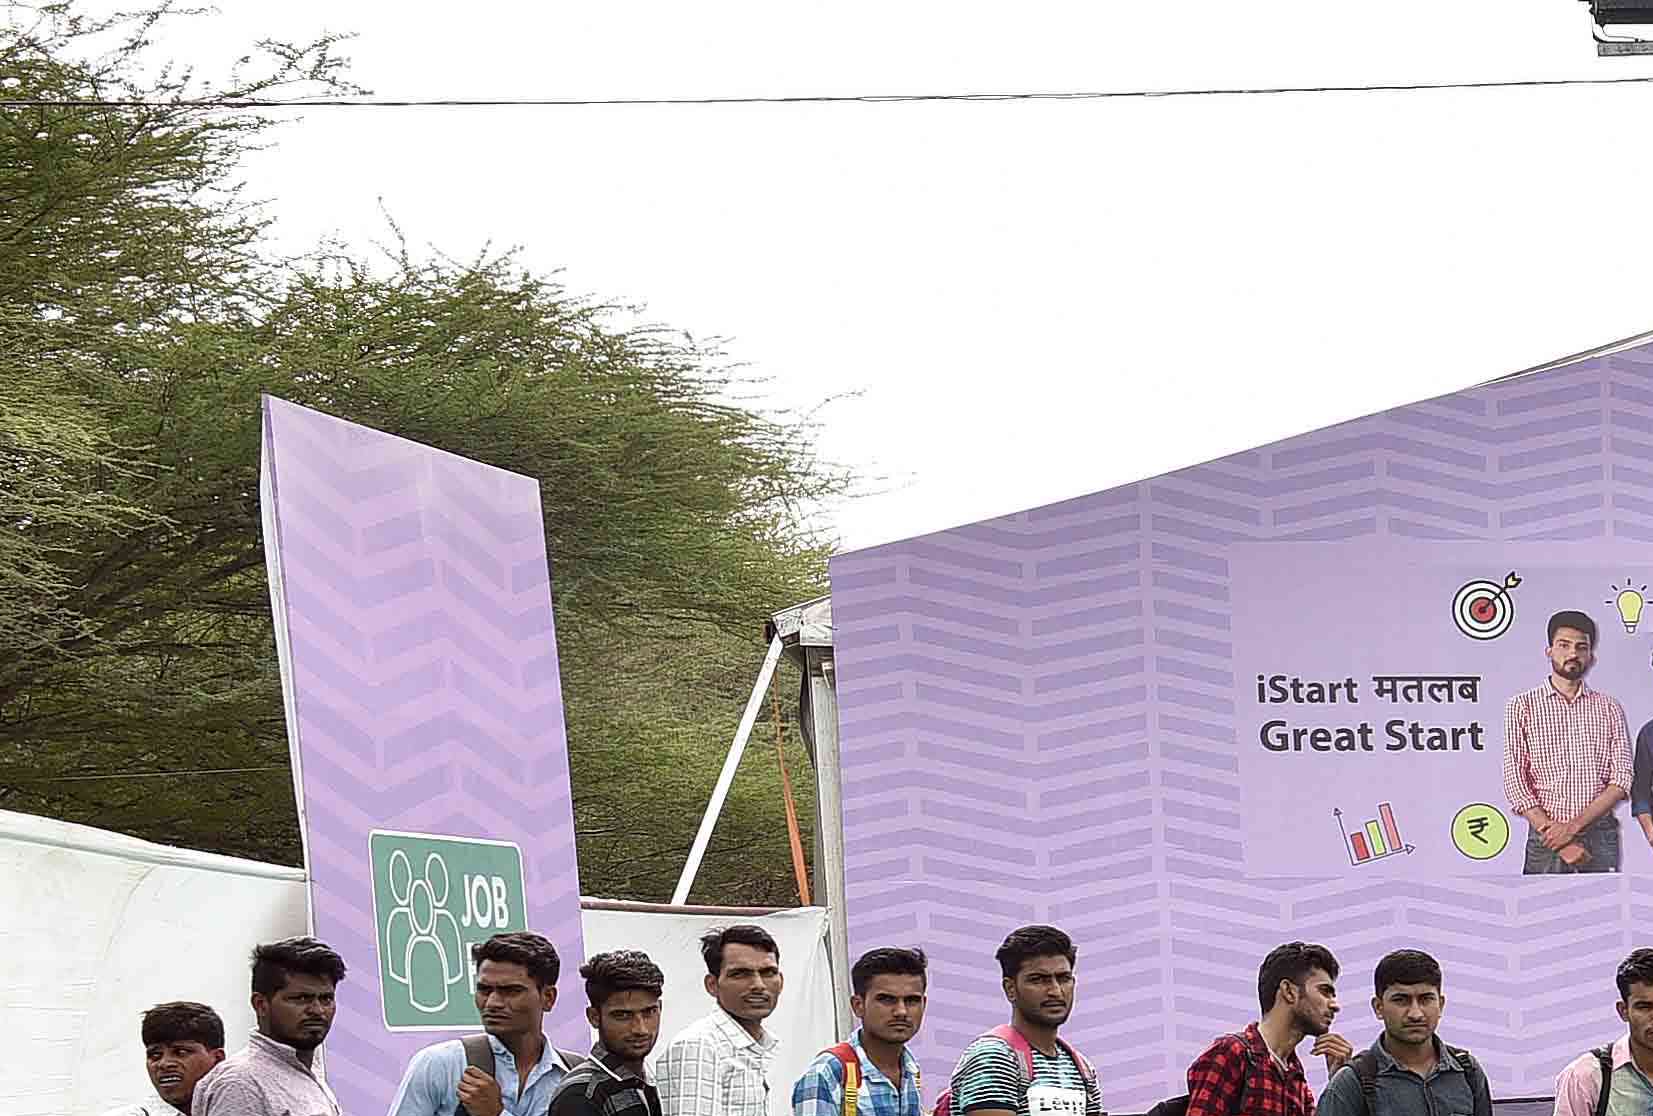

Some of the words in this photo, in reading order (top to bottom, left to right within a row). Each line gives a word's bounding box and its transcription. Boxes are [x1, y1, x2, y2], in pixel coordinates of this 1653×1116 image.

[1257, 674, 1358, 704] iStart
[1373, 675, 1482, 704] मतलब
[1259, 720, 1374, 752] Great
[1385, 719, 1485, 752] Start
[461, 874, 509, 929] JOB
